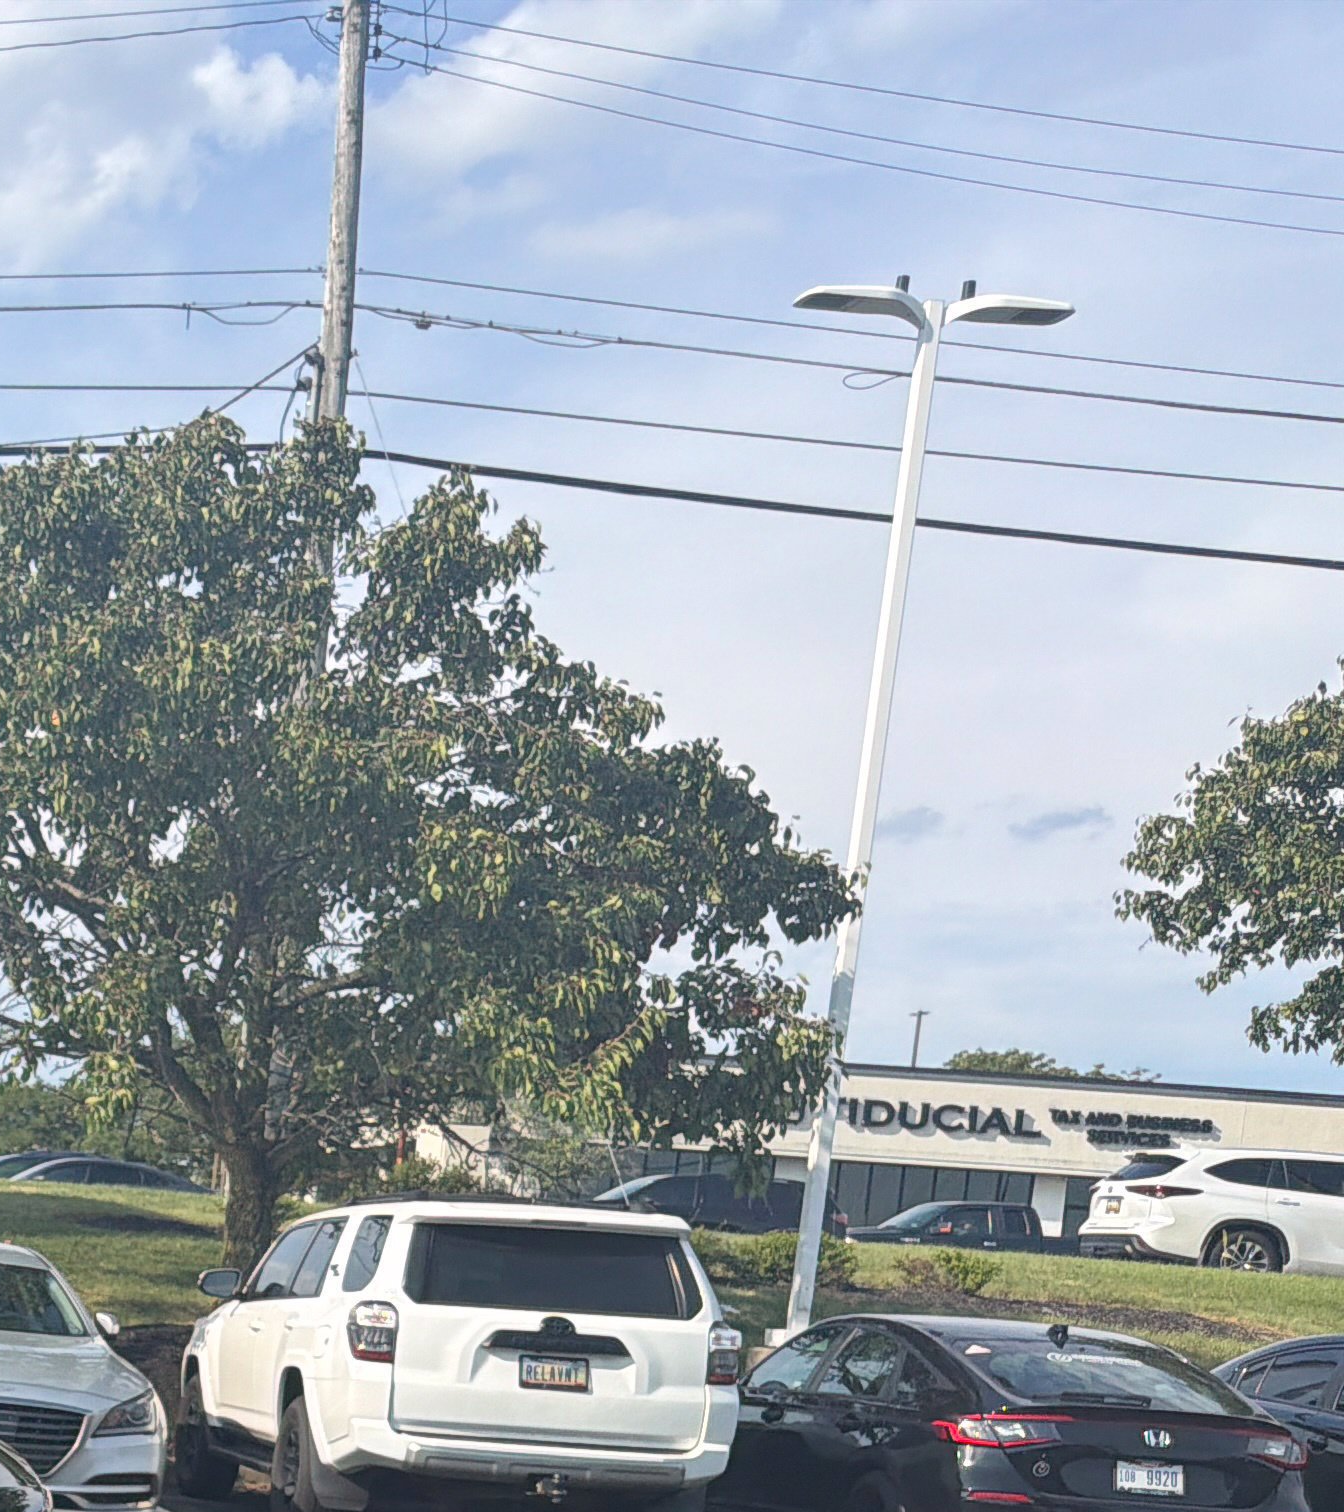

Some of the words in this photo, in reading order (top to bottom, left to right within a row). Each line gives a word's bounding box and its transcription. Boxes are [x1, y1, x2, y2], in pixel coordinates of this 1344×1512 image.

[1049, 1108, 1082, 1125] TAX
[1085, 1111, 1123, 1128] AND
[1146, 1469, 1178, 1488] 9920
